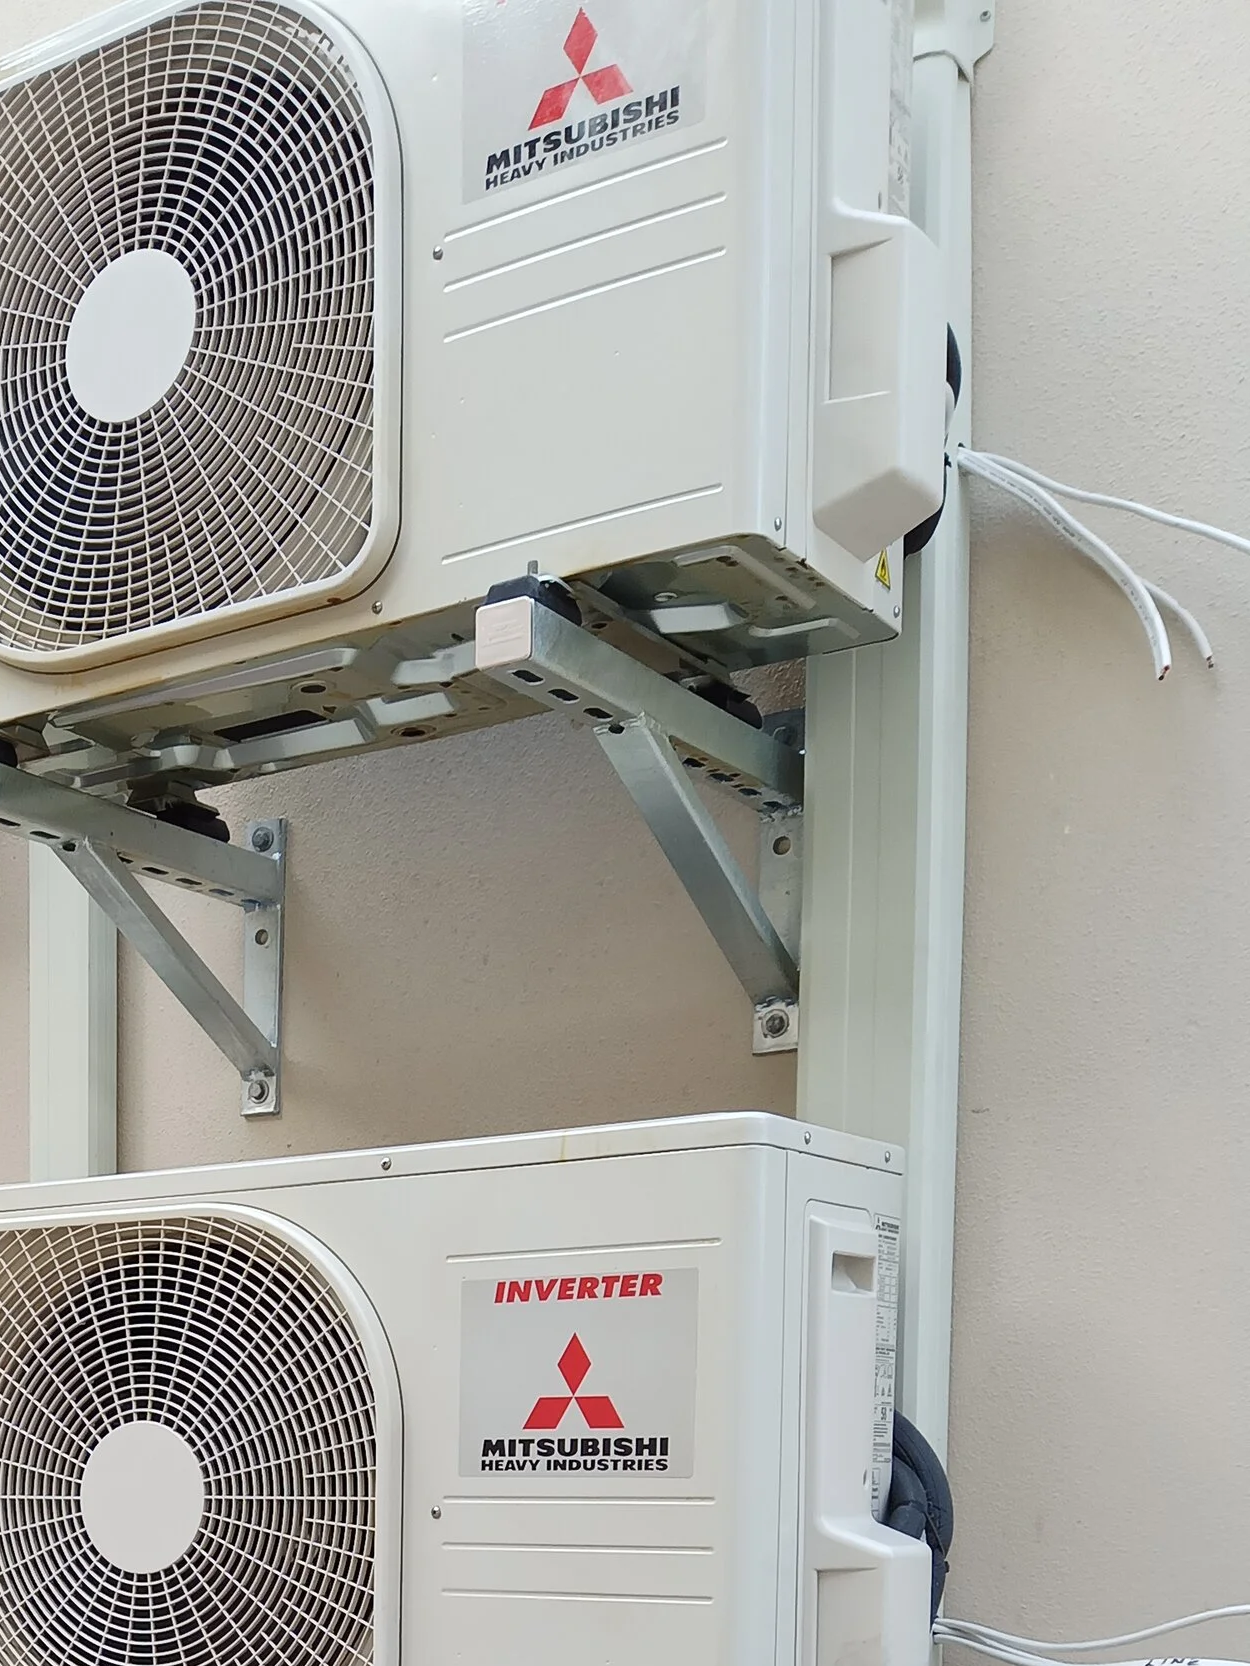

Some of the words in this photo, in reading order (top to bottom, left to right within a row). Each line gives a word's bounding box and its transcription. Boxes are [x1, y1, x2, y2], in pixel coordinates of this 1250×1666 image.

[485, 85, 680, 176] MITSUBISHI
[485, 160, 546, 191] HEAVY
[553, 109, 680, 167] INDUSTRIES
[494, 1273, 664, 1304] INVERTER
[481, 1437, 669, 1457] MITSUBISHI
[481, 1459, 540, 1472] HEAVY
[546, 1458, 669, 1471] INDUSTRIES
